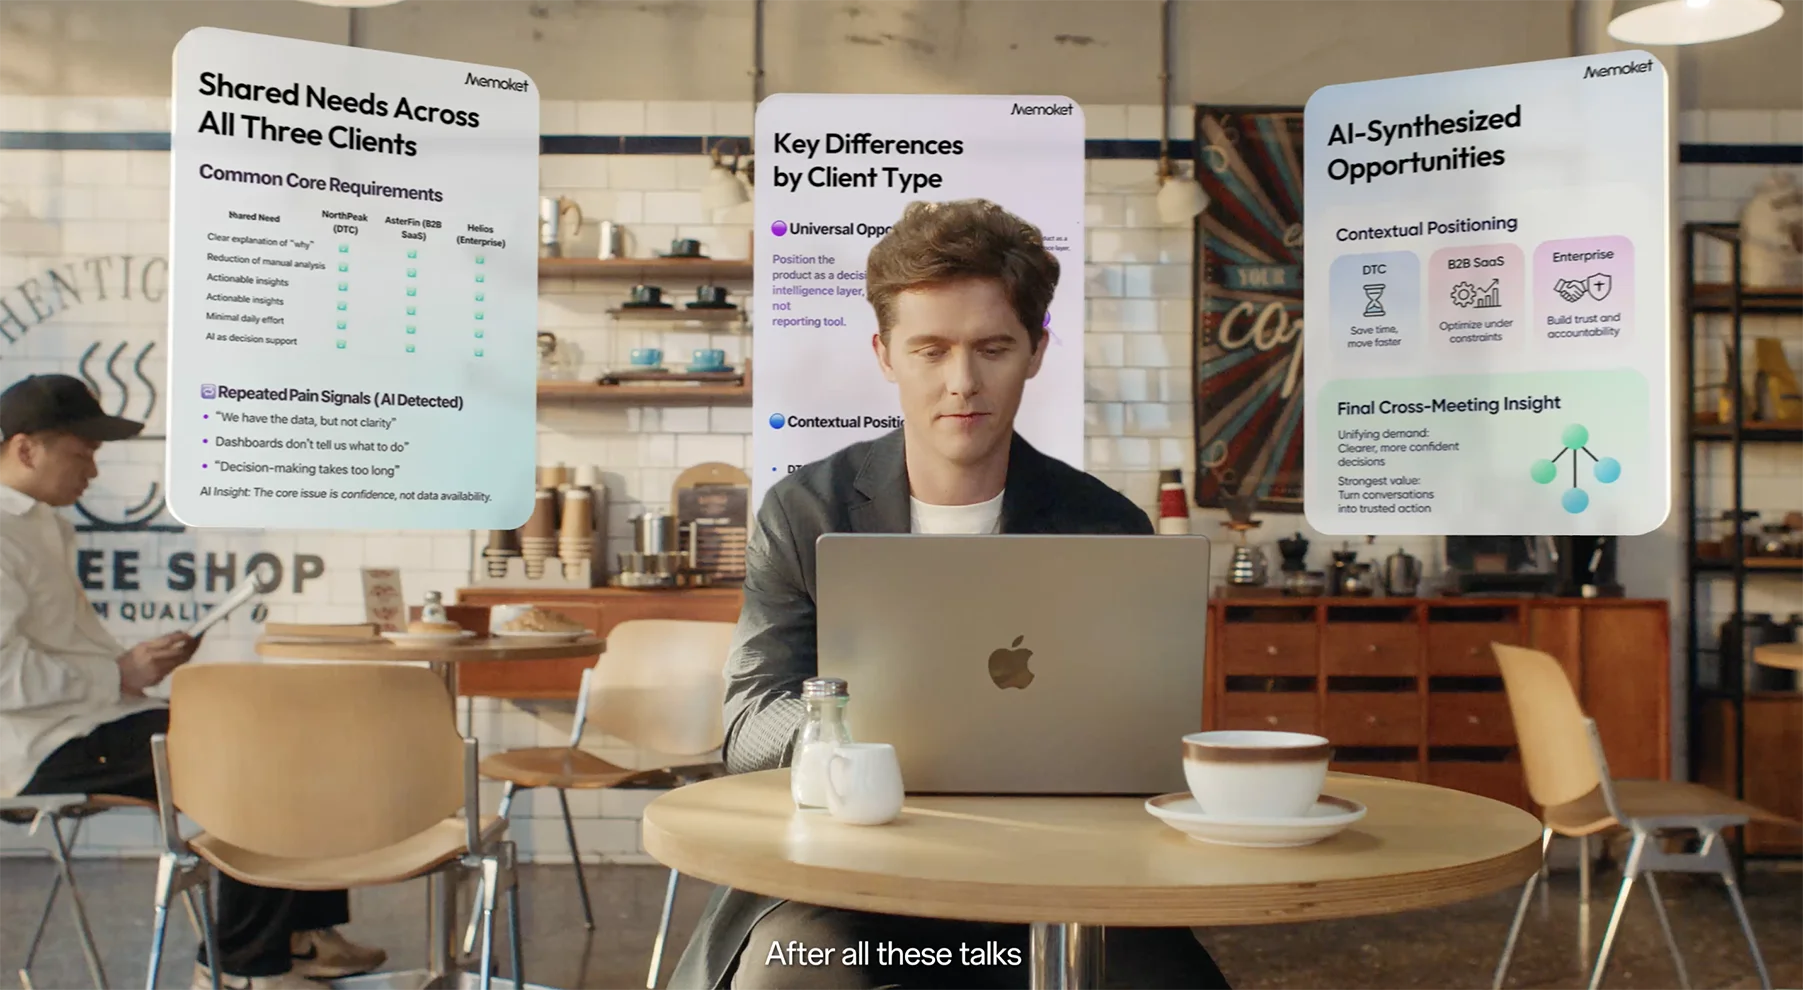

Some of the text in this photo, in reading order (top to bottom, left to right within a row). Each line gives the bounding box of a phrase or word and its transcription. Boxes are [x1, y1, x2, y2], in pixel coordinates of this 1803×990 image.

[1583, 59, 1653, 79] Memoket
[465, 72, 529, 93] Memoket
[199, 71, 480, 128] Shared Needs Across
[1011, 104, 1074, 116] Memoket
[1327, 104, 1522, 146] AI-Synthesized
[198, 111, 417, 156] All Three Clients
[774, 132, 964, 158] Key Differences
[1327, 145, 1505, 184] Opportunities
[200, 164, 443, 203] Common Core Requirements
[773, 166, 942, 193] by Client Type
[258, 214, 280, 222] Need
[322, 210, 368, 222] NorthPeak
[385, 216, 442, 229] AsterFin (B2B
[333, 225, 358, 235] (DTC)
[468, 224, 494, 233] Helios
[790, 222, 854, 235] Universal
[1336, 216, 1518, 242] Contextual Positioning
[207, 232, 230, 242] Clear
[232, 236, 278, 246] explanation
[401, 231, 426, 241] SaaS)
[457, 236, 506, 249] (Enterprise)
[207, 253, 250, 264] Reduction
[262, 259, 292, 267] manual
[294, 261, 326, 270] analysis
[773, 254, 835, 264] Position the
[1448, 256, 1504, 269] B2B SaaS
[1553, 249, 1614, 263] Enterprise
[772, 271, 812, 281] product
[814, 272, 825, 280] as
[828, 272, 834, 280] a
[1362, 264, 1387, 275] DTC
[207, 273, 289, 287] Actionable insights
[1238, 268, 1286, 286] YOUR
[772, 285, 865, 297] intelligence layer,
[206, 293, 284, 306] Actionable insights
[772, 302, 791, 310] not
[206, 312, 284, 324] Minimal daily effort
[772, 316, 846, 328] reporting tool.
[1547, 313, 1621, 325] Build trust and
[1351, 325, 1398, 335] Save time,
[1439, 319, 1513, 332] Optimize under
[1449, 333, 1503, 343] constraints
[1547, 327, 1620, 339] accountability
[229, 334, 264, 343] decision
[266, 337, 297, 346] support
[1348, 338, 1401, 348] move faster
[218, 385, 287, 402] Repeated
[290, 388, 319, 402] Pain
[321, 389, 371, 406] Signals
[398, 394, 464, 411] Detected)
[1338, 396, 1561, 415] Final Cross-Meeting Insight
[242, 413, 268, 423] have
[270, 414, 288, 424] the
[290, 415, 318, 427] data,
[320, 416, 338, 426] but
[341, 418, 358, 427] not
[787, 416, 860, 428] Contextual
[1338, 428, 1429, 441] Unifying demand:
[215, 436, 283, 448] Dashboards
[316, 440, 332, 450] tell
[334, 442, 347, 450] us
[349, 441, 374, 451] what
[377, 442, 388, 452] to
[1338, 443, 1378, 453] Clearer,
[1409, 442, 1459, 452] confident
[1338, 457, 1385, 466] decisions
[319, 464, 348, 475] takes
[351, 466, 369, 475] too
[1338, 476, 1421, 488] Strongest value:
[214, 487, 251, 498] Insight:
[254, 487, 274, 498] The
[276, 490, 298, 498] core
[300, 488, 327, 498] issue
[330, 489, 339, 498] is
[341, 489, 397, 501] confidence,
[399, 491, 415, 500] not
[417, 491, 439, 500] data
[440, 492, 492, 503] availability.
[1339, 490, 1434, 499] Turn conversations
[1338, 504, 1431, 513] into trusted action
[167, 552, 325, 594] SHOP
[120, 603, 230, 622] QUALI
